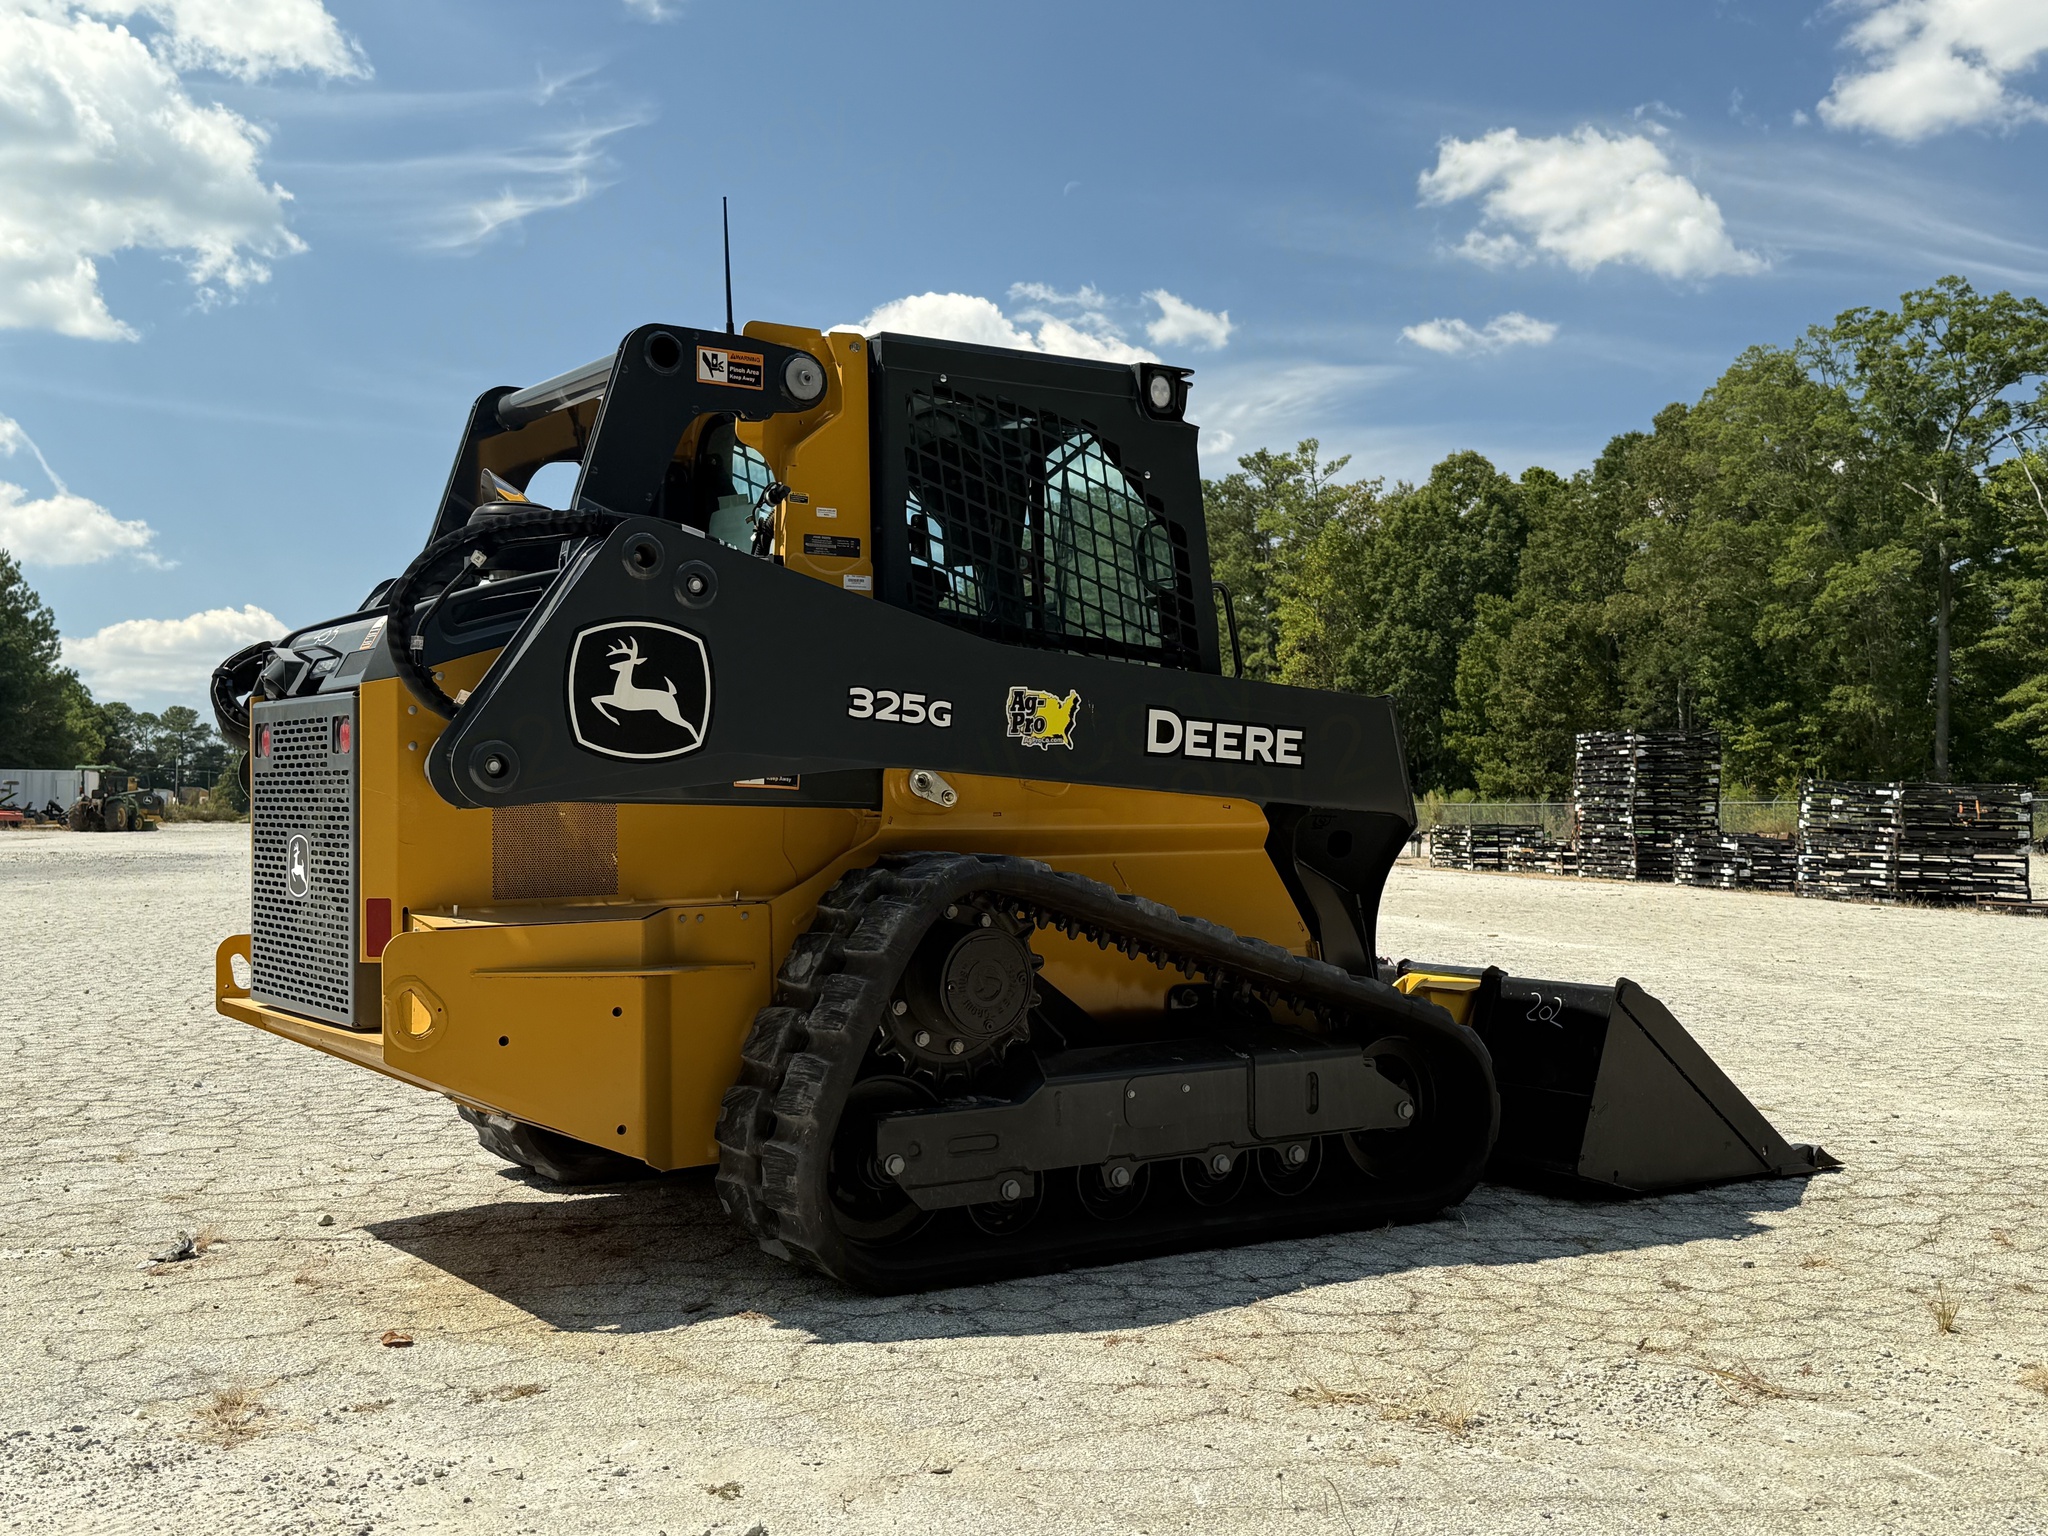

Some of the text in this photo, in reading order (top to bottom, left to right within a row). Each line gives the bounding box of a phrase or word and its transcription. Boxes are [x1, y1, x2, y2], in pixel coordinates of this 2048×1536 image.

[729, 366, 760, 376] Pinch Area
[735, 354, 761, 363] WARNING
[848, 687, 952, 727] 325G
[1009, 690, 1046, 717] Ag-
[1009, 711, 1047, 735] Pro
[1147, 708, 1304, 766] DEERE
[1526, 991, 1564, 1029] 202
